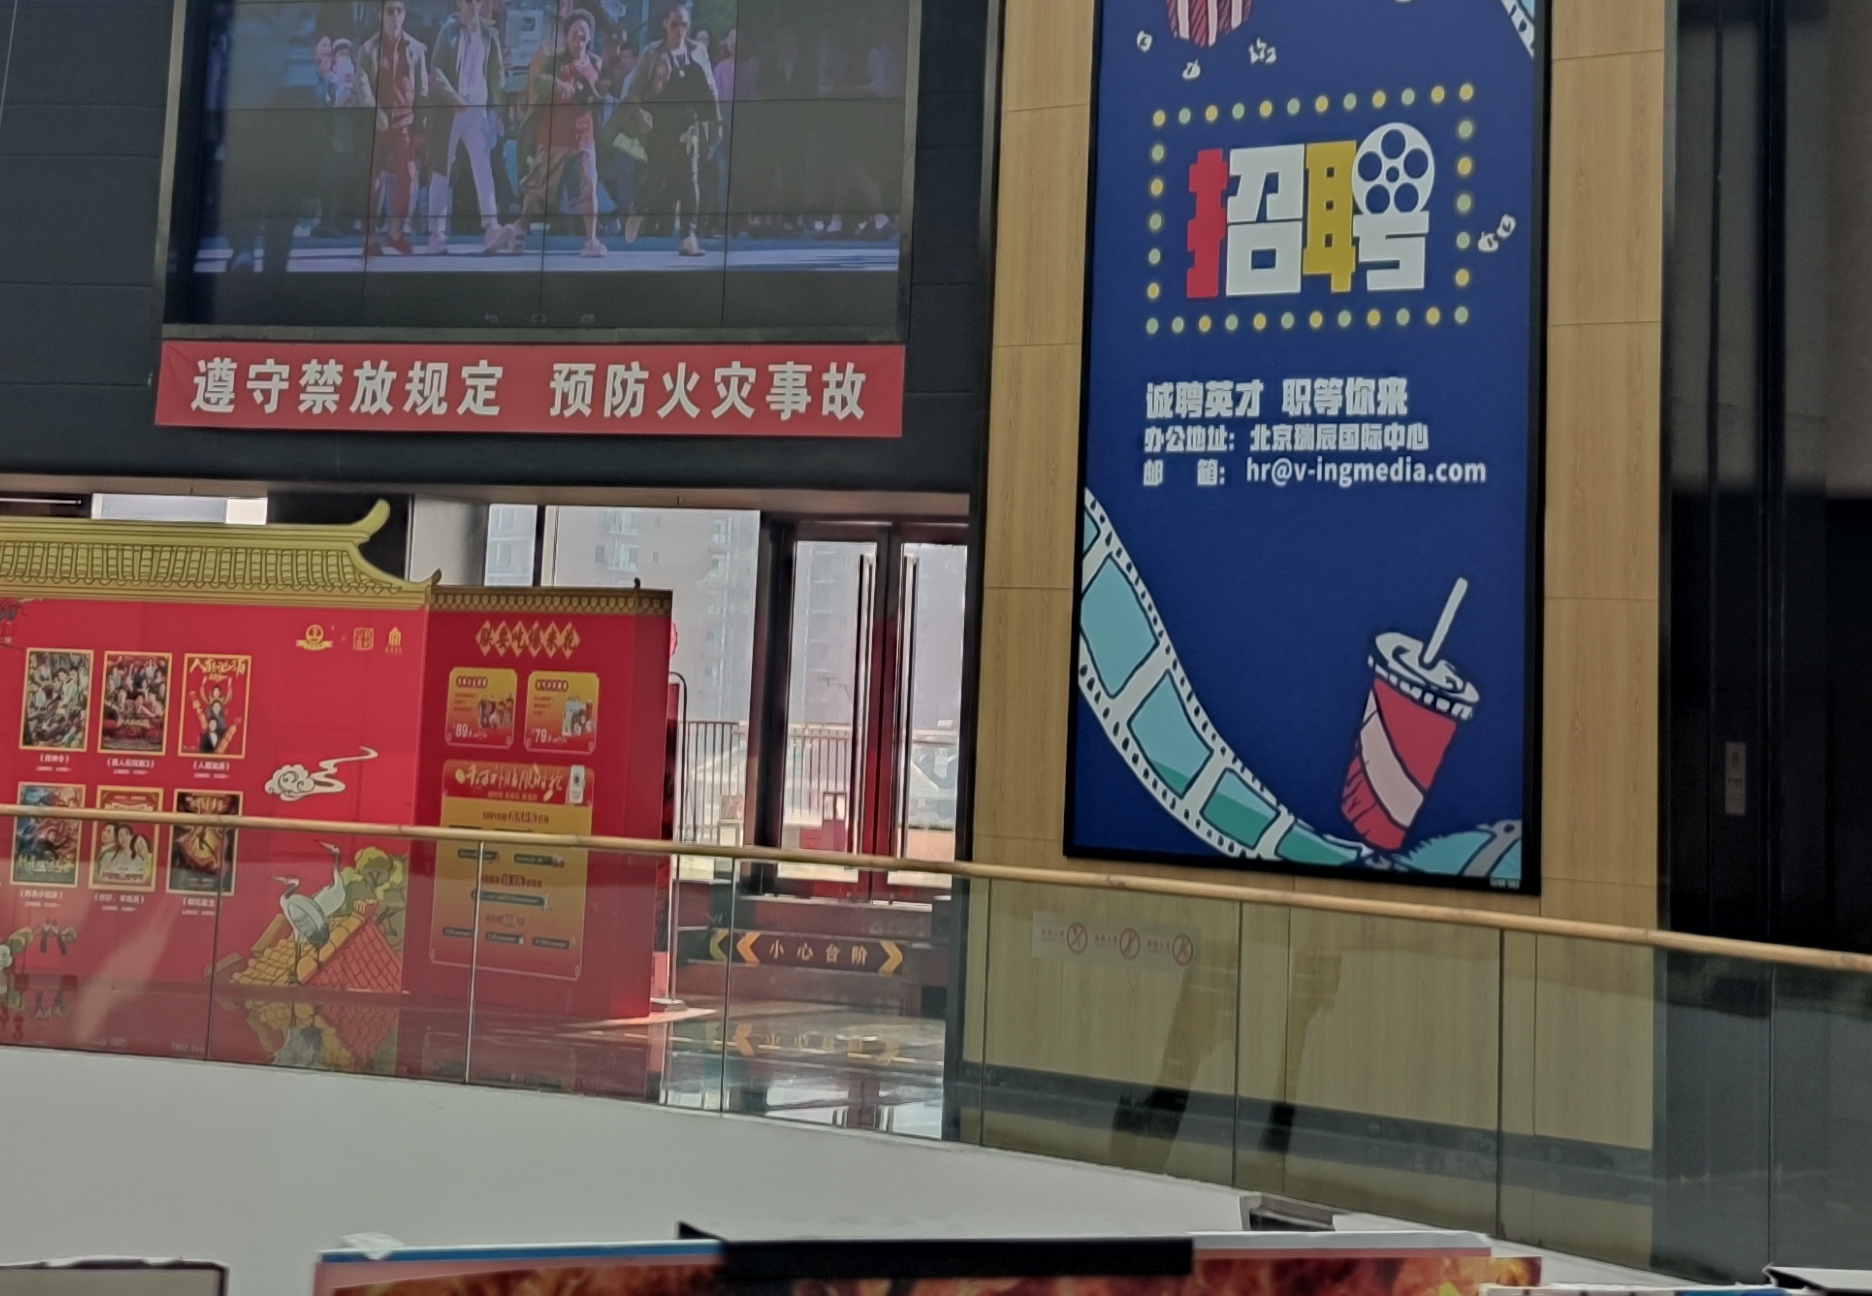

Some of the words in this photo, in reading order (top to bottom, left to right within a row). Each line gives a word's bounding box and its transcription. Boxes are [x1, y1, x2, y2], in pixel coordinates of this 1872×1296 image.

[1186, 122, 1436, 299] 招聘
[190, 356, 505, 417] 遵守禁放规定
[549, 361, 866, 421] 预防火灾事故
[1146, 380, 1264, 418] 诚聘英才
[1281, 376, 1408, 417] 职等你来
[1246, 457, 1487, 487] hr@v-ingmedia.com
[769, 939, 868, 966] 小心台阶
